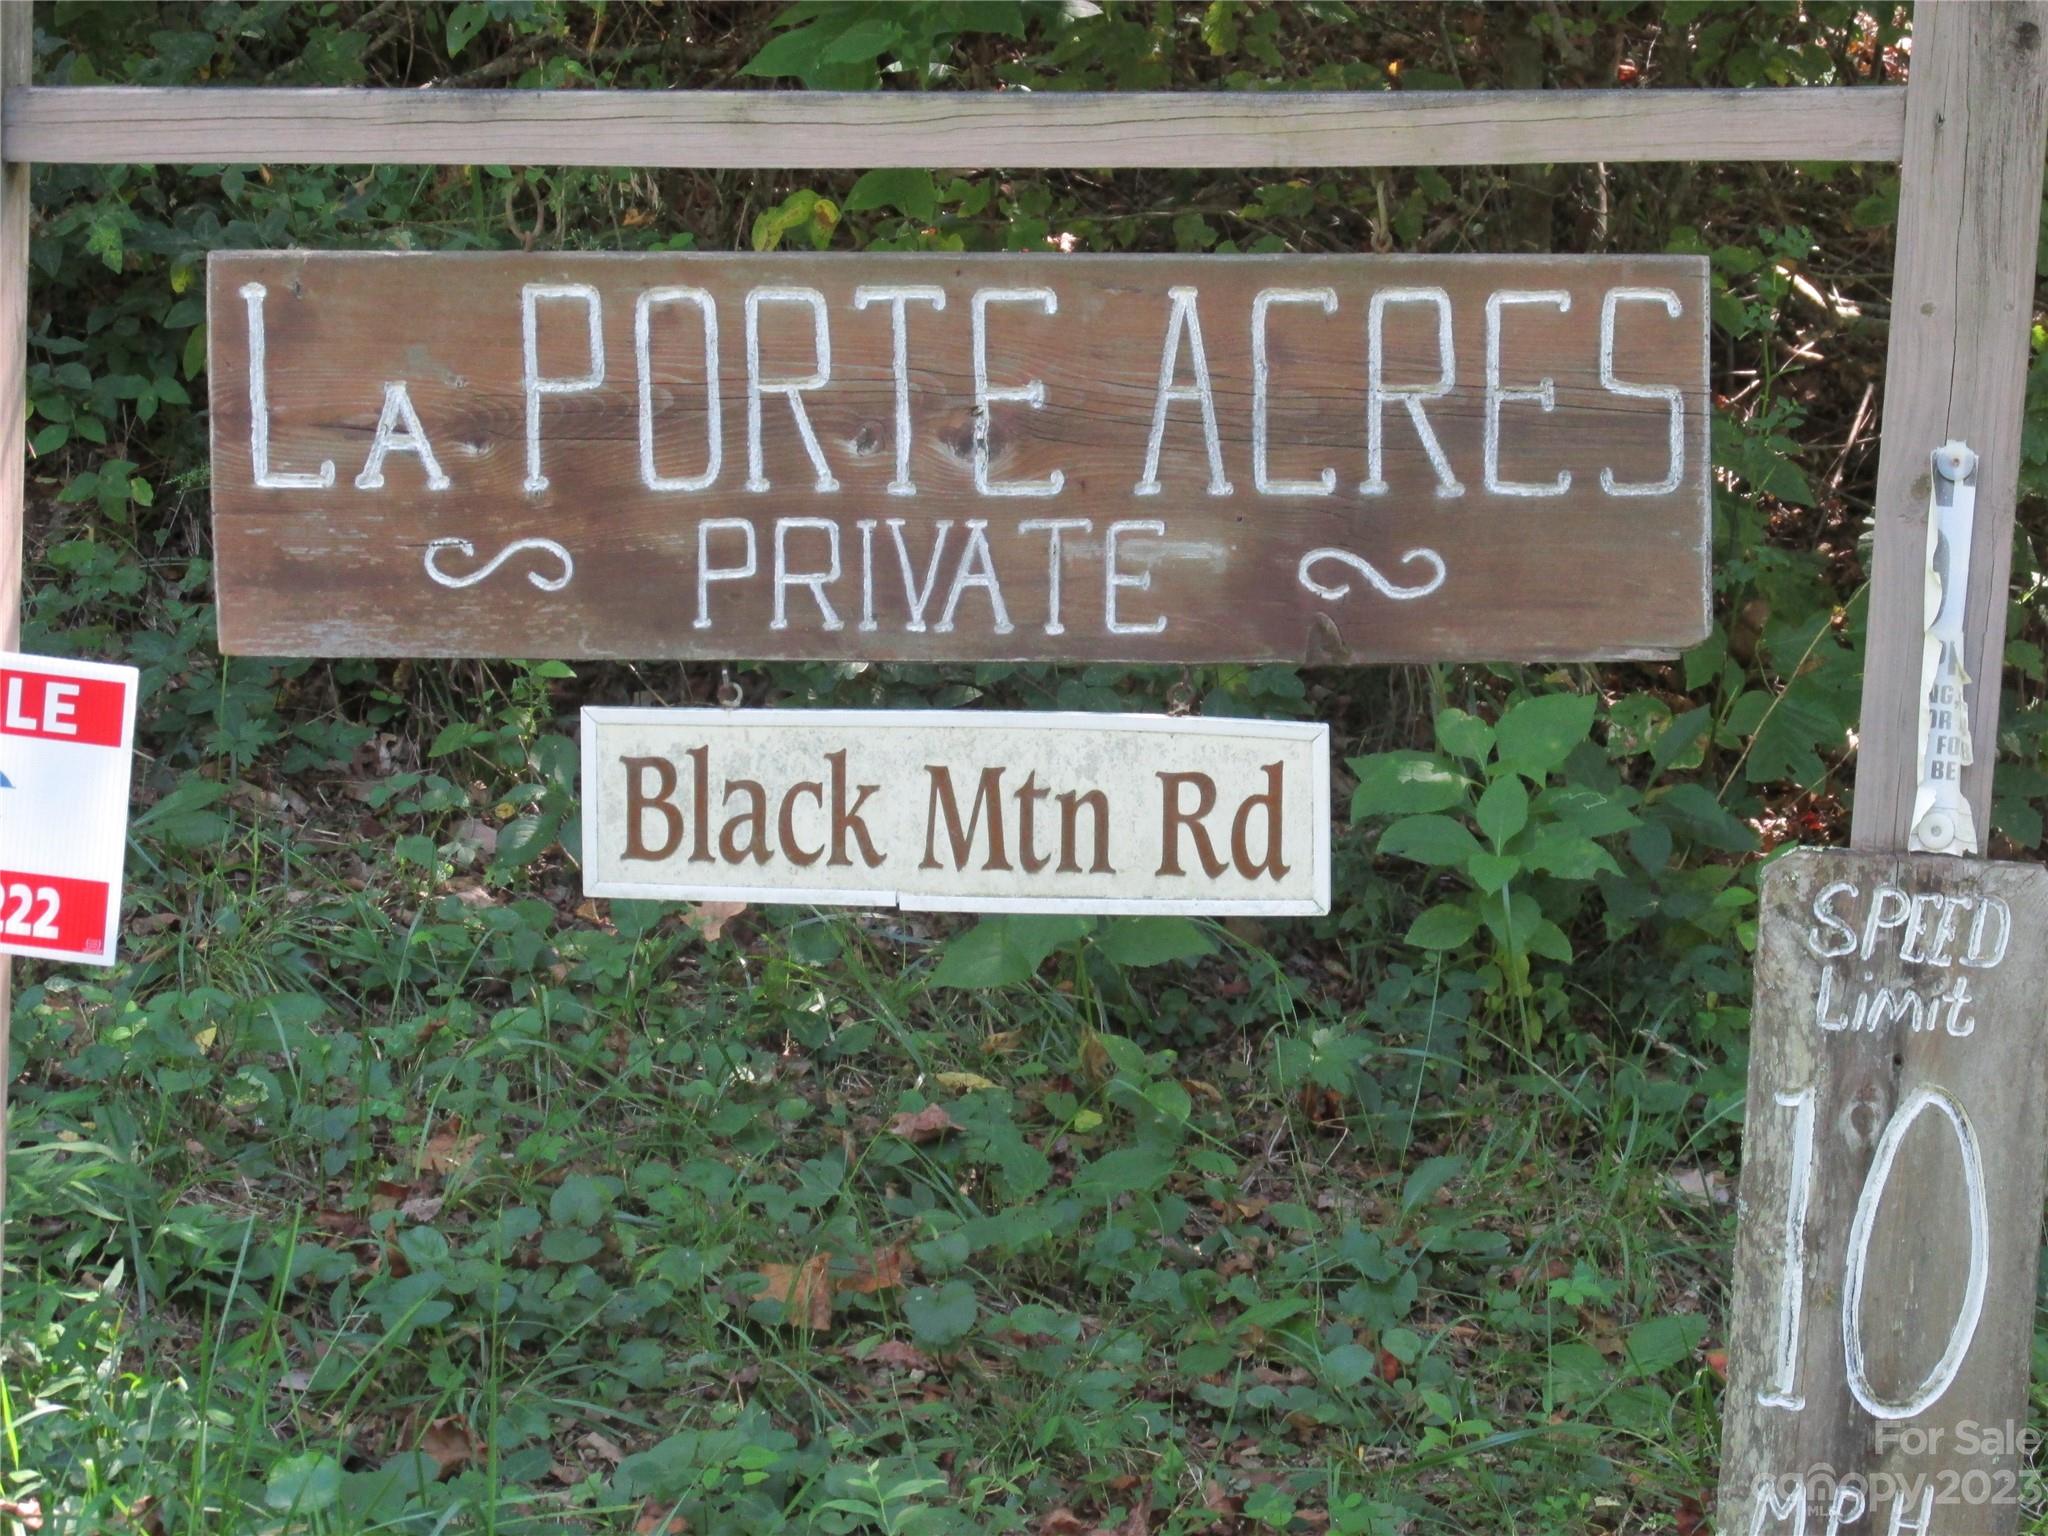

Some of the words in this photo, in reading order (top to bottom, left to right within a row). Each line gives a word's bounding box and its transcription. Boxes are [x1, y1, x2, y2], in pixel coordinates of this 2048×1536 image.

[522, 283, 1065, 499] PORTE
[1133, 285, 1686, 498] ACRES
[693, 516, 1168, 637] PRIVATE
[618, 744, 887, 869] Black
[918, 764, 1116, 875] Mtn
[1154, 759, 1291, 881] Rd
[1808, 881, 2011, 969] SPEED
[1757, 1083, 1990, 1420] 10
[1749, 1480, 1934, 1536] MPH
